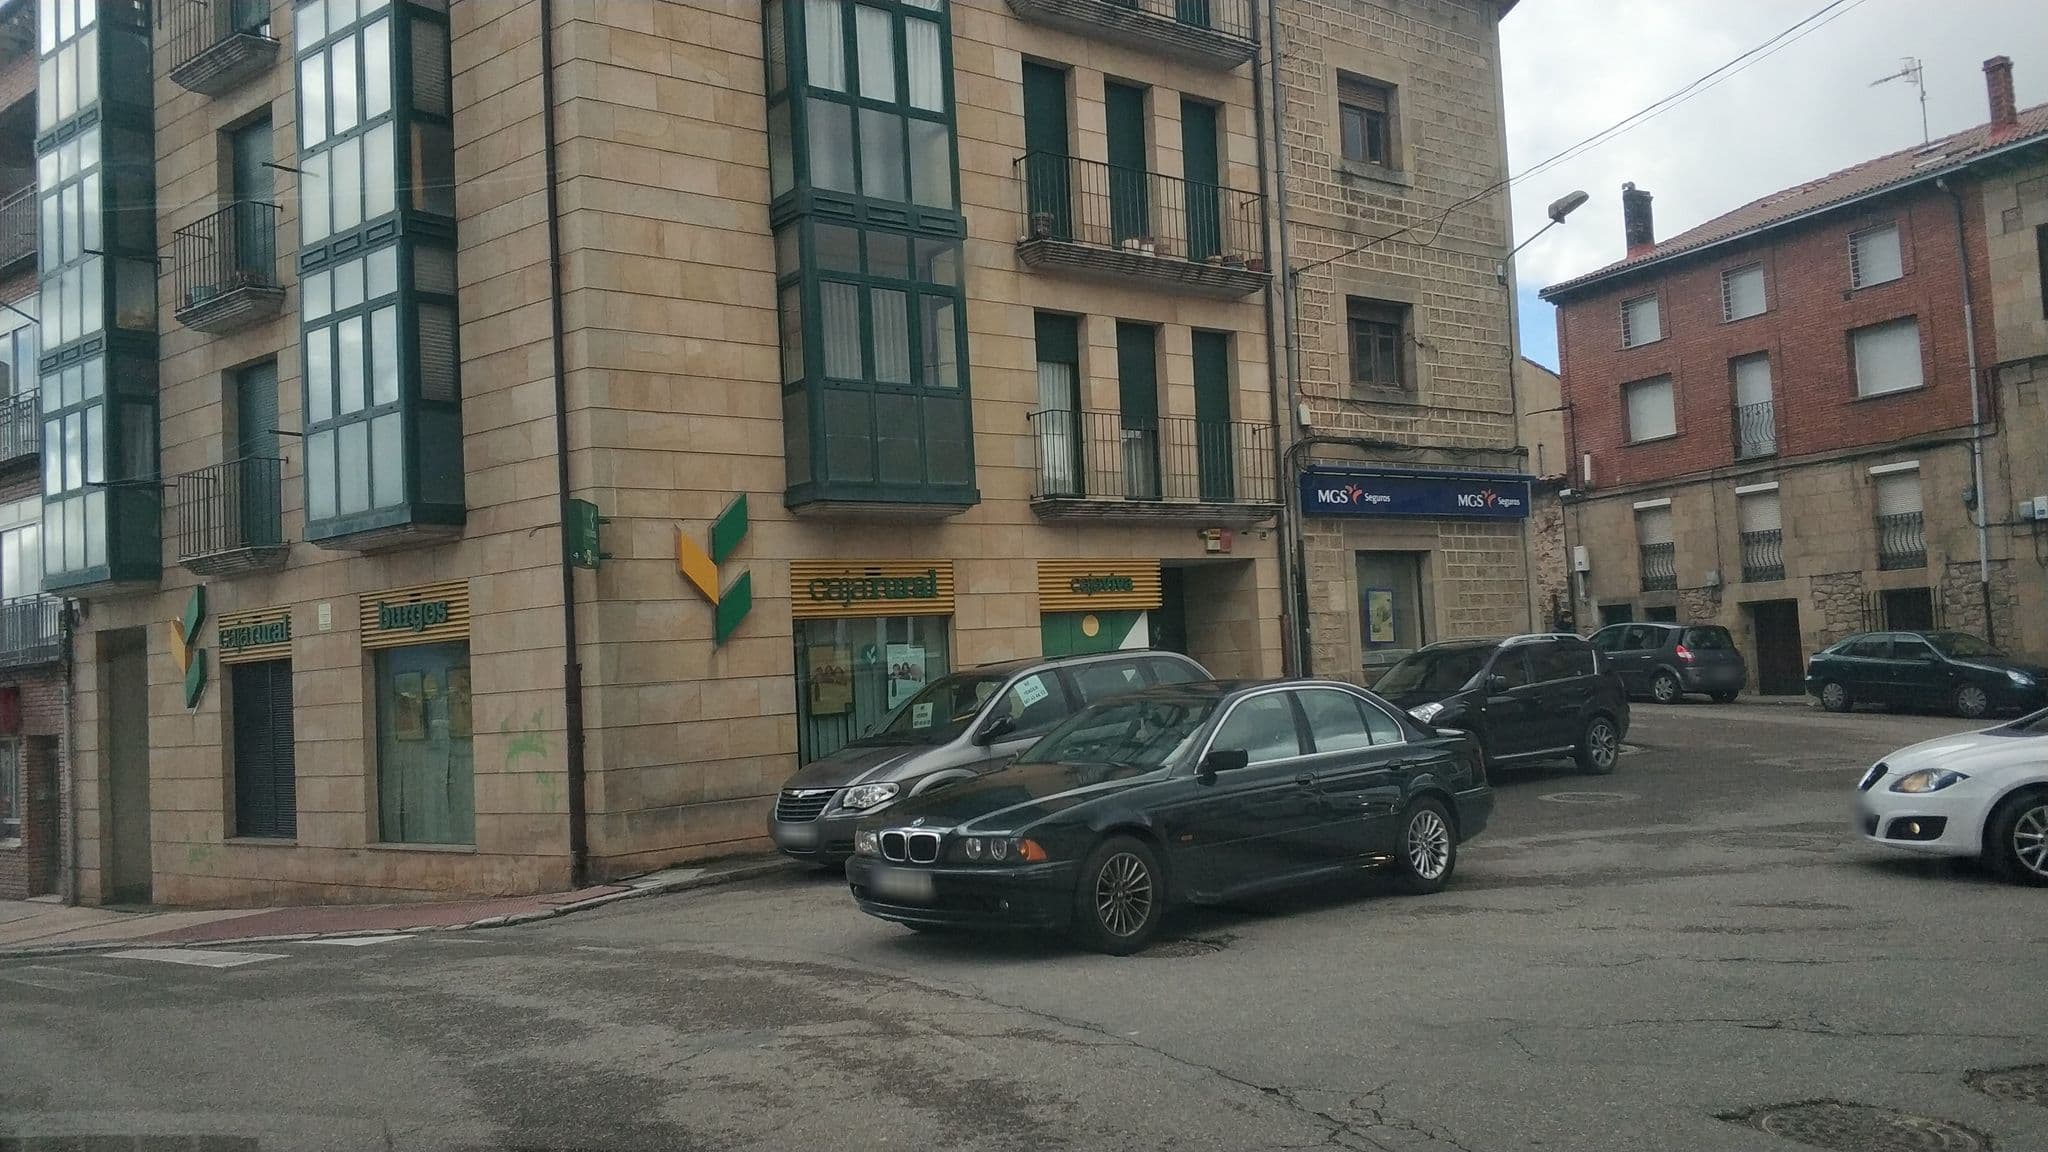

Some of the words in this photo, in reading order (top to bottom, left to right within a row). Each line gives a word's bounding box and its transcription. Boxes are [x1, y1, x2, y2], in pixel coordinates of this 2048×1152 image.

[1317, 489, 1349, 504] MGS
[1364, 492, 1391, 505] Seguros
[1457, 494, 1484, 508] MGS
[1497, 496, 1521, 508] Seguros
[810, 567, 940, 608] cajarural
[377, 600, 448, 633] burgos
